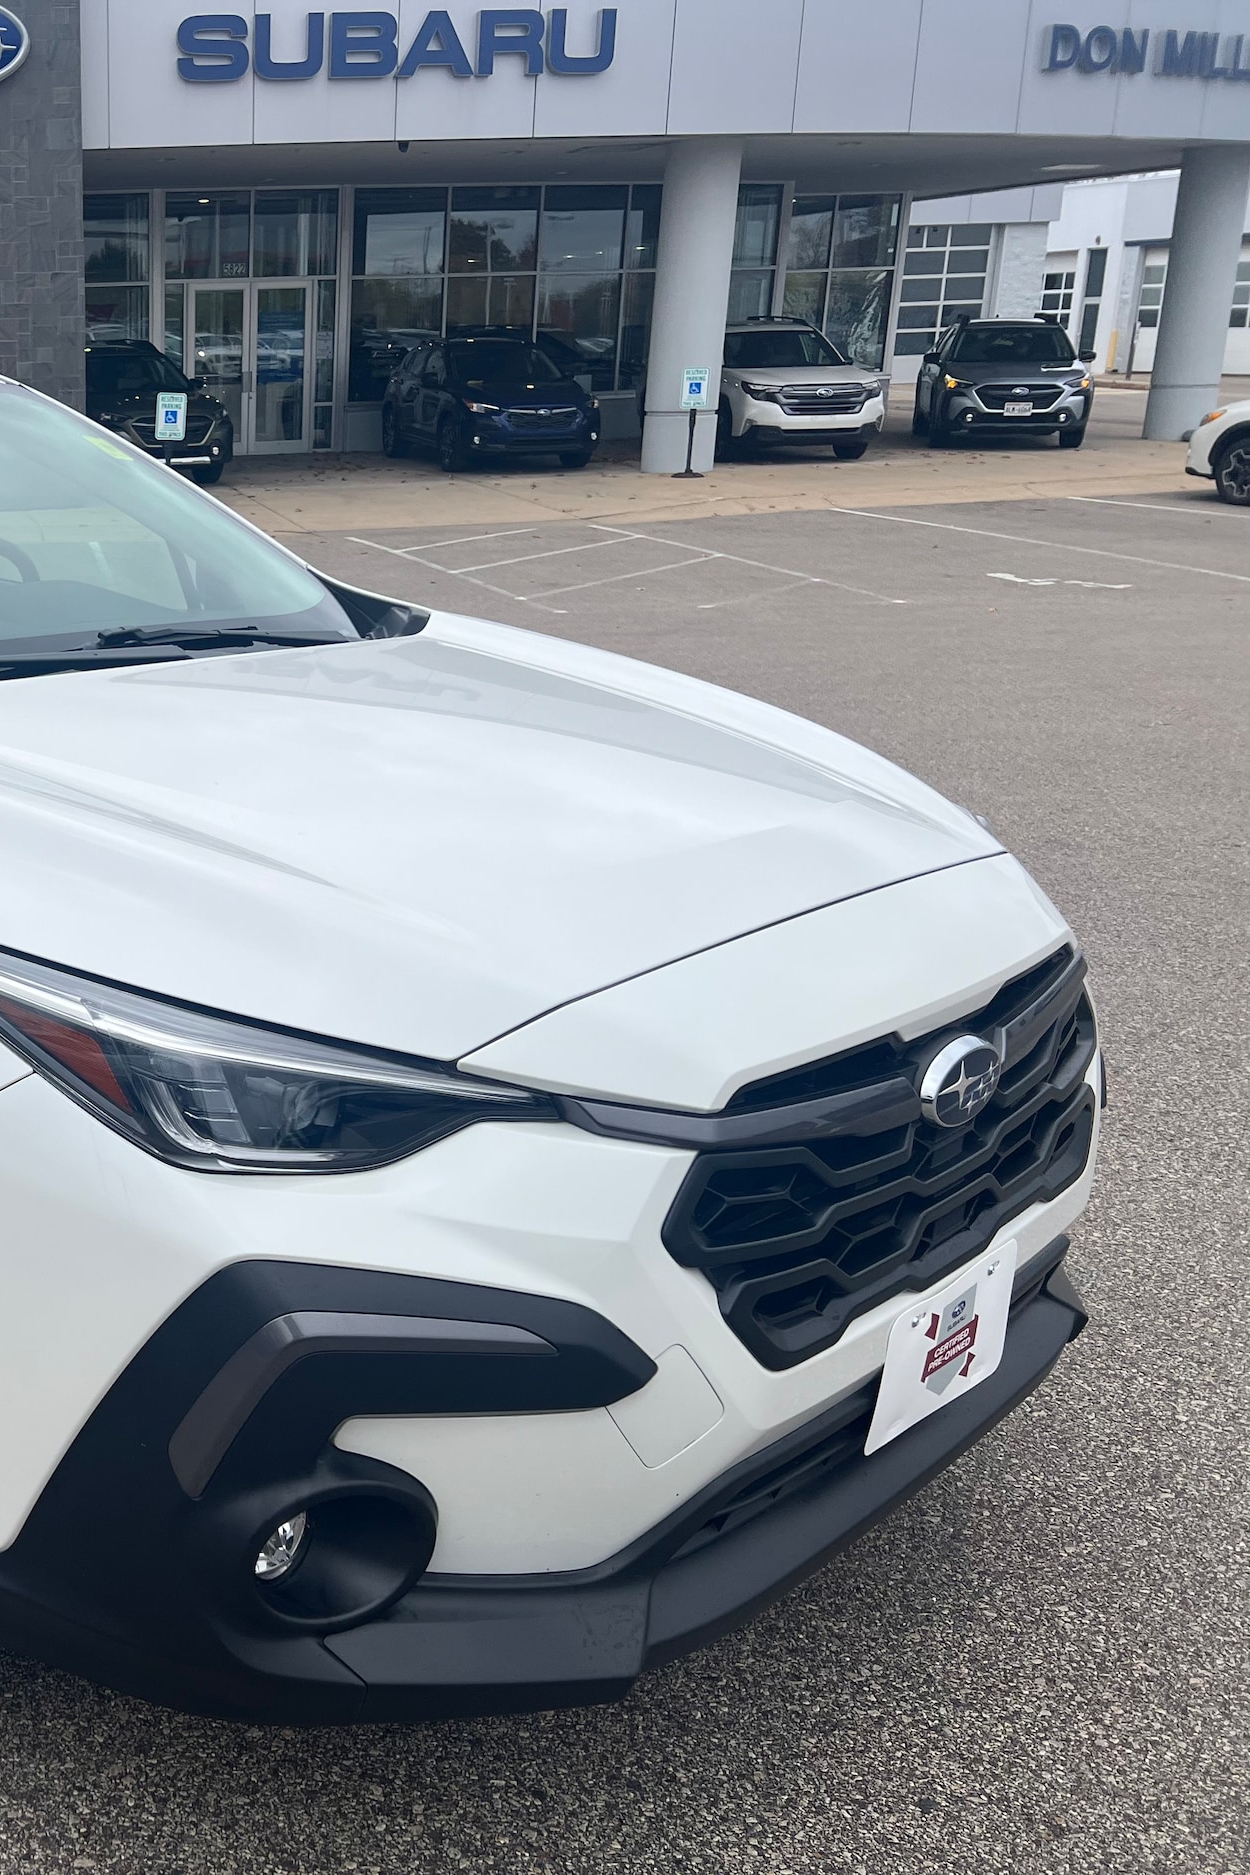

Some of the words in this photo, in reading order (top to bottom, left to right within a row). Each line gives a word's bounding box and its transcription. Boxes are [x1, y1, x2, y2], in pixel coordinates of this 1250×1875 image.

[176, 8, 617, 83] SUBARU
[1046, 23, 1150, 74] DON
[222, 263, 247, 275] 5822
[928, 1336, 971, 1372] PRE-OWNED
[934, 1327, 970, 1358] CERTIFIED
